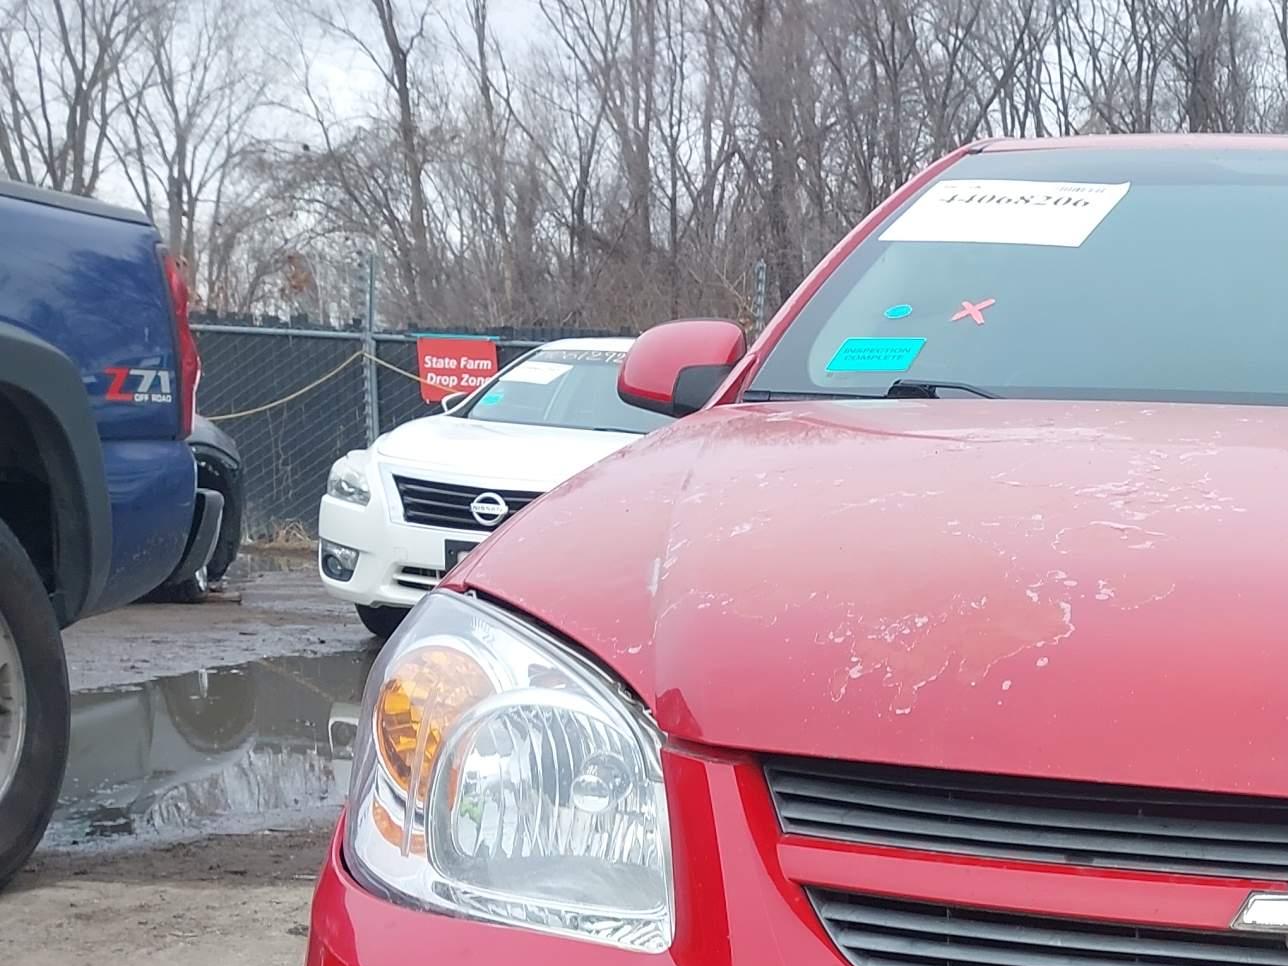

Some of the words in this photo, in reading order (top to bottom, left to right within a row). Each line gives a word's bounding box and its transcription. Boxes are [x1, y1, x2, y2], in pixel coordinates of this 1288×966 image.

[939, 193, 1090, 207] 44068206
[843, 346, 912, 355] INSPECTION
[424, 355, 457, 369] State
[460, 356, 492, 370] Farm
[104, 367, 171, 401] Z71
[427, 372, 458, 387] Drop
[134, 394, 150, 402] OFF
[151, 394, 172, 403] ROAD
[472, 505, 504, 514] NISSAN
